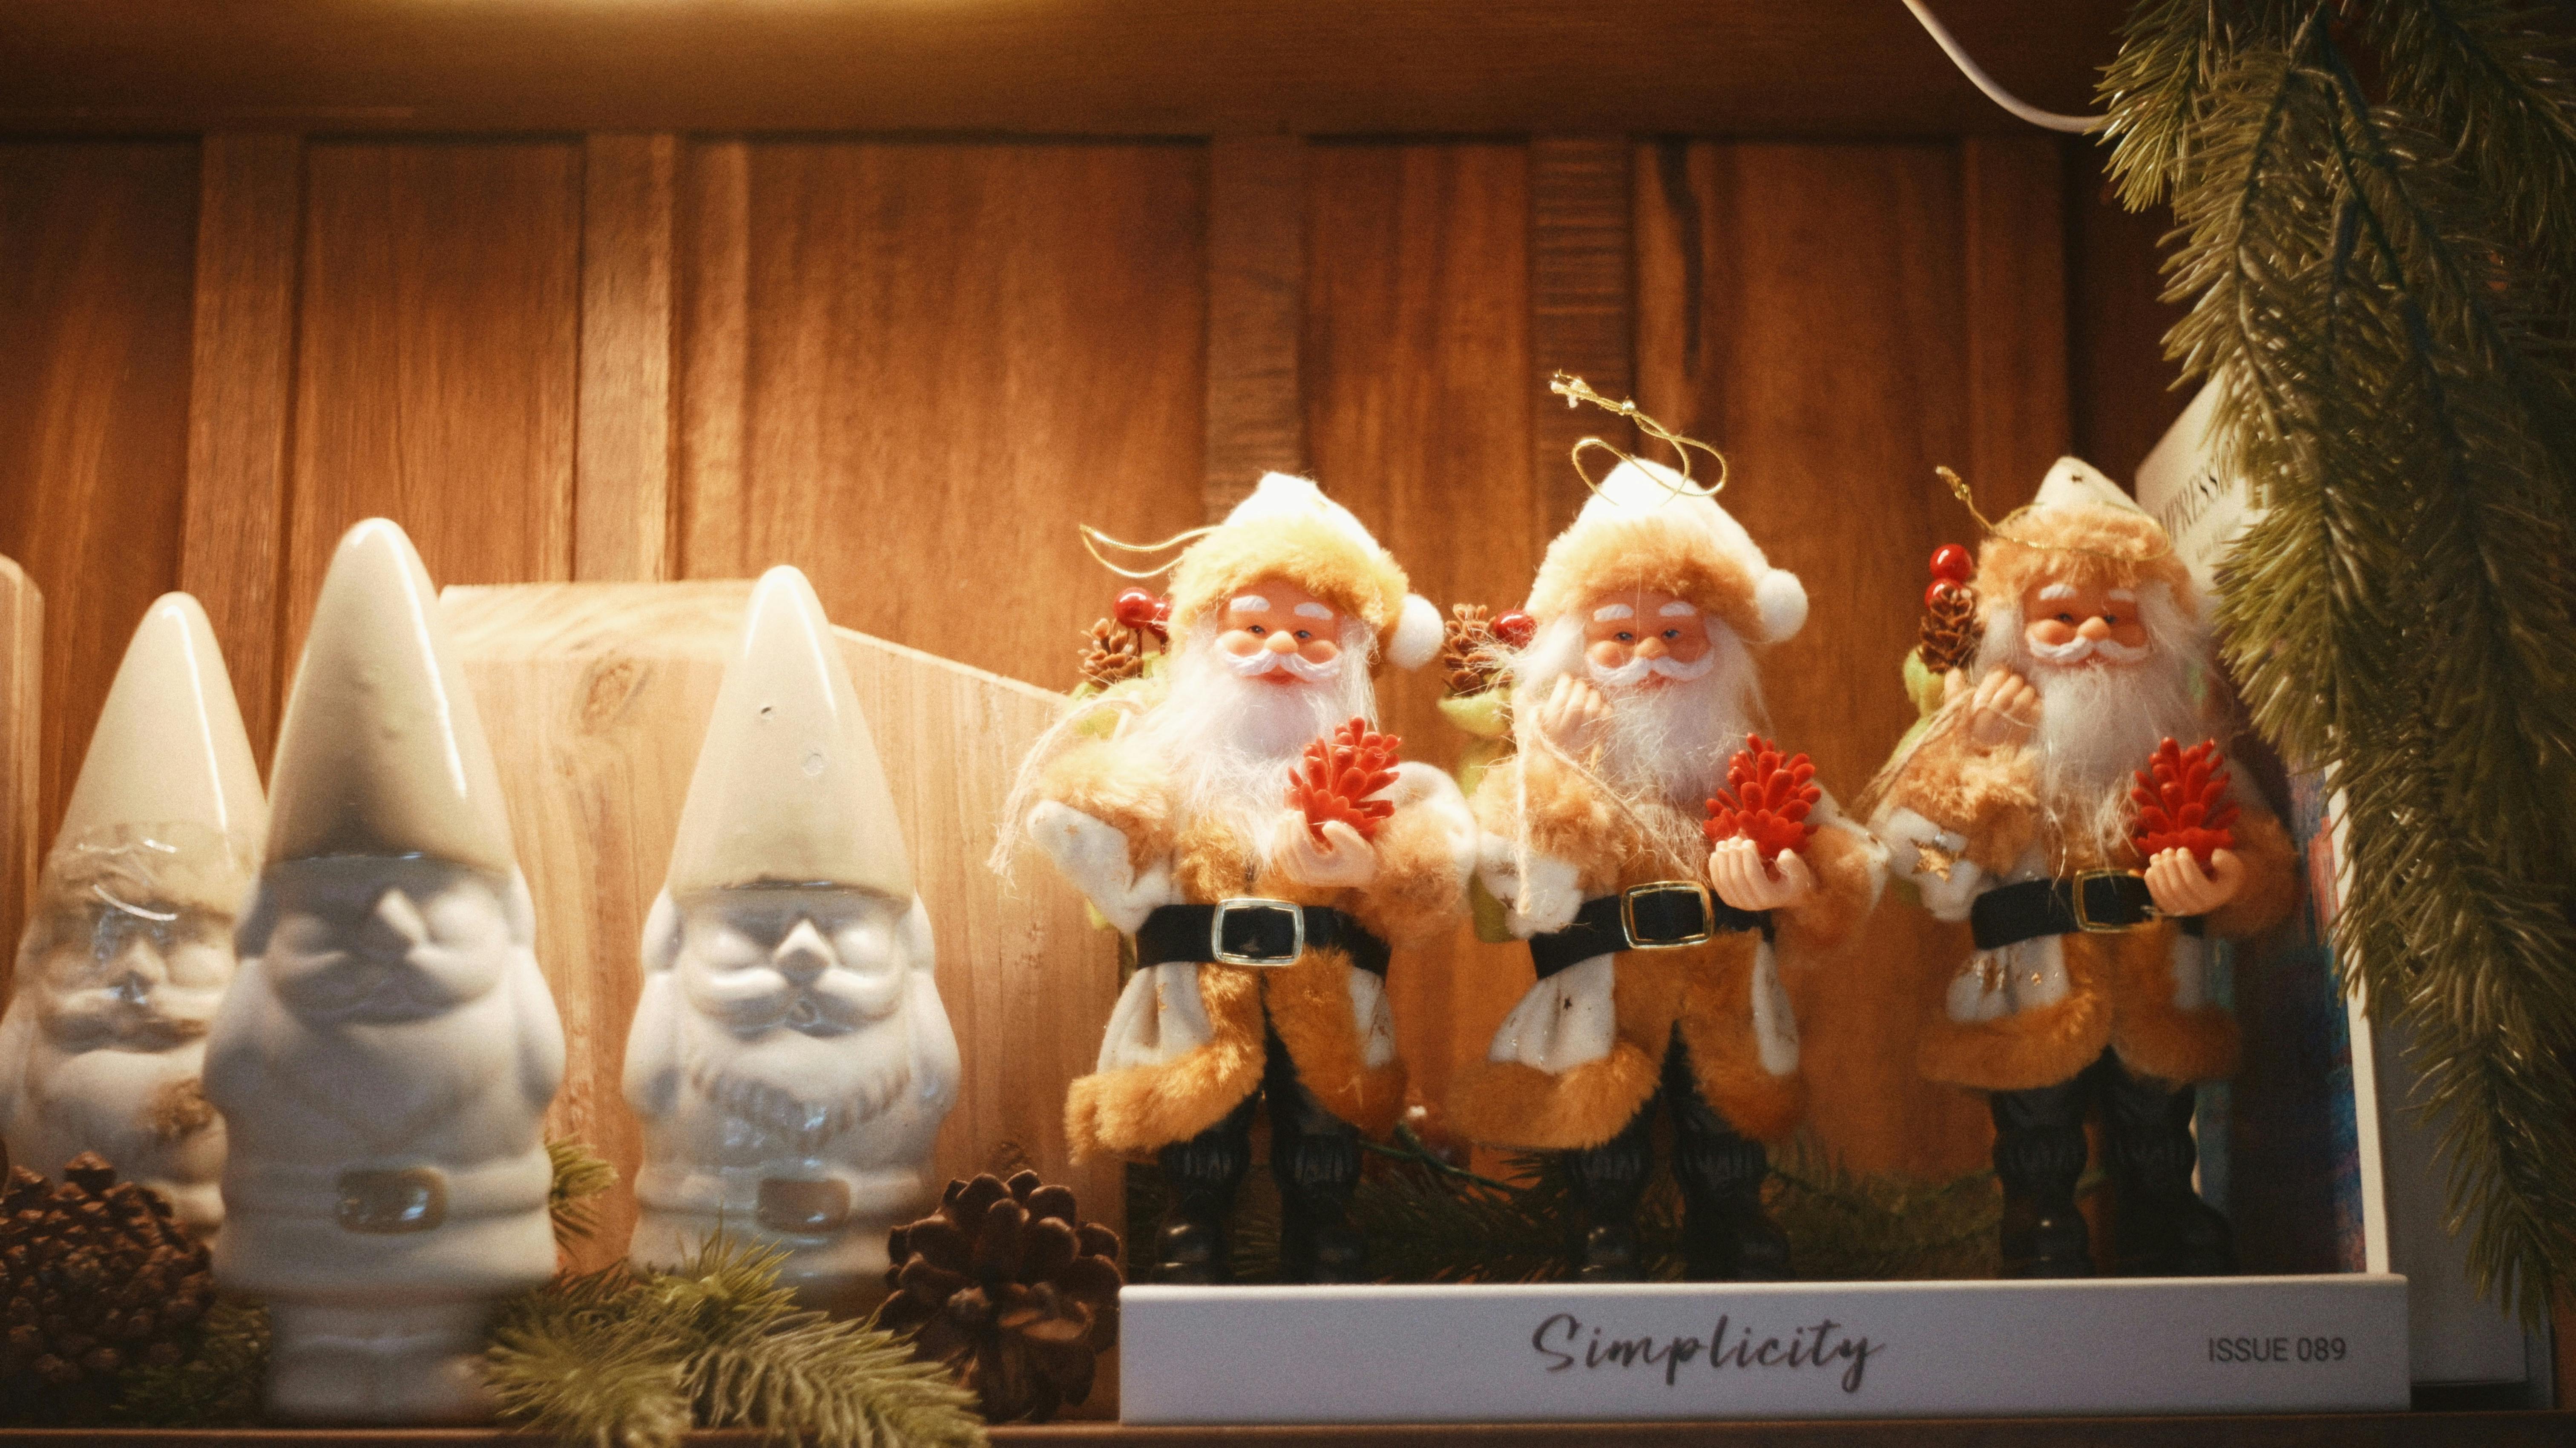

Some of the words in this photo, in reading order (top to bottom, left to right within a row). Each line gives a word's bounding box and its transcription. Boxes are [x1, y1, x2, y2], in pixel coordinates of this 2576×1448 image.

[1532, 1313, 1885, 1393] Simplicity
[2208, 1337, 2288, 1362] ISSUE
[2297, 1336, 2346, 1362] 089
